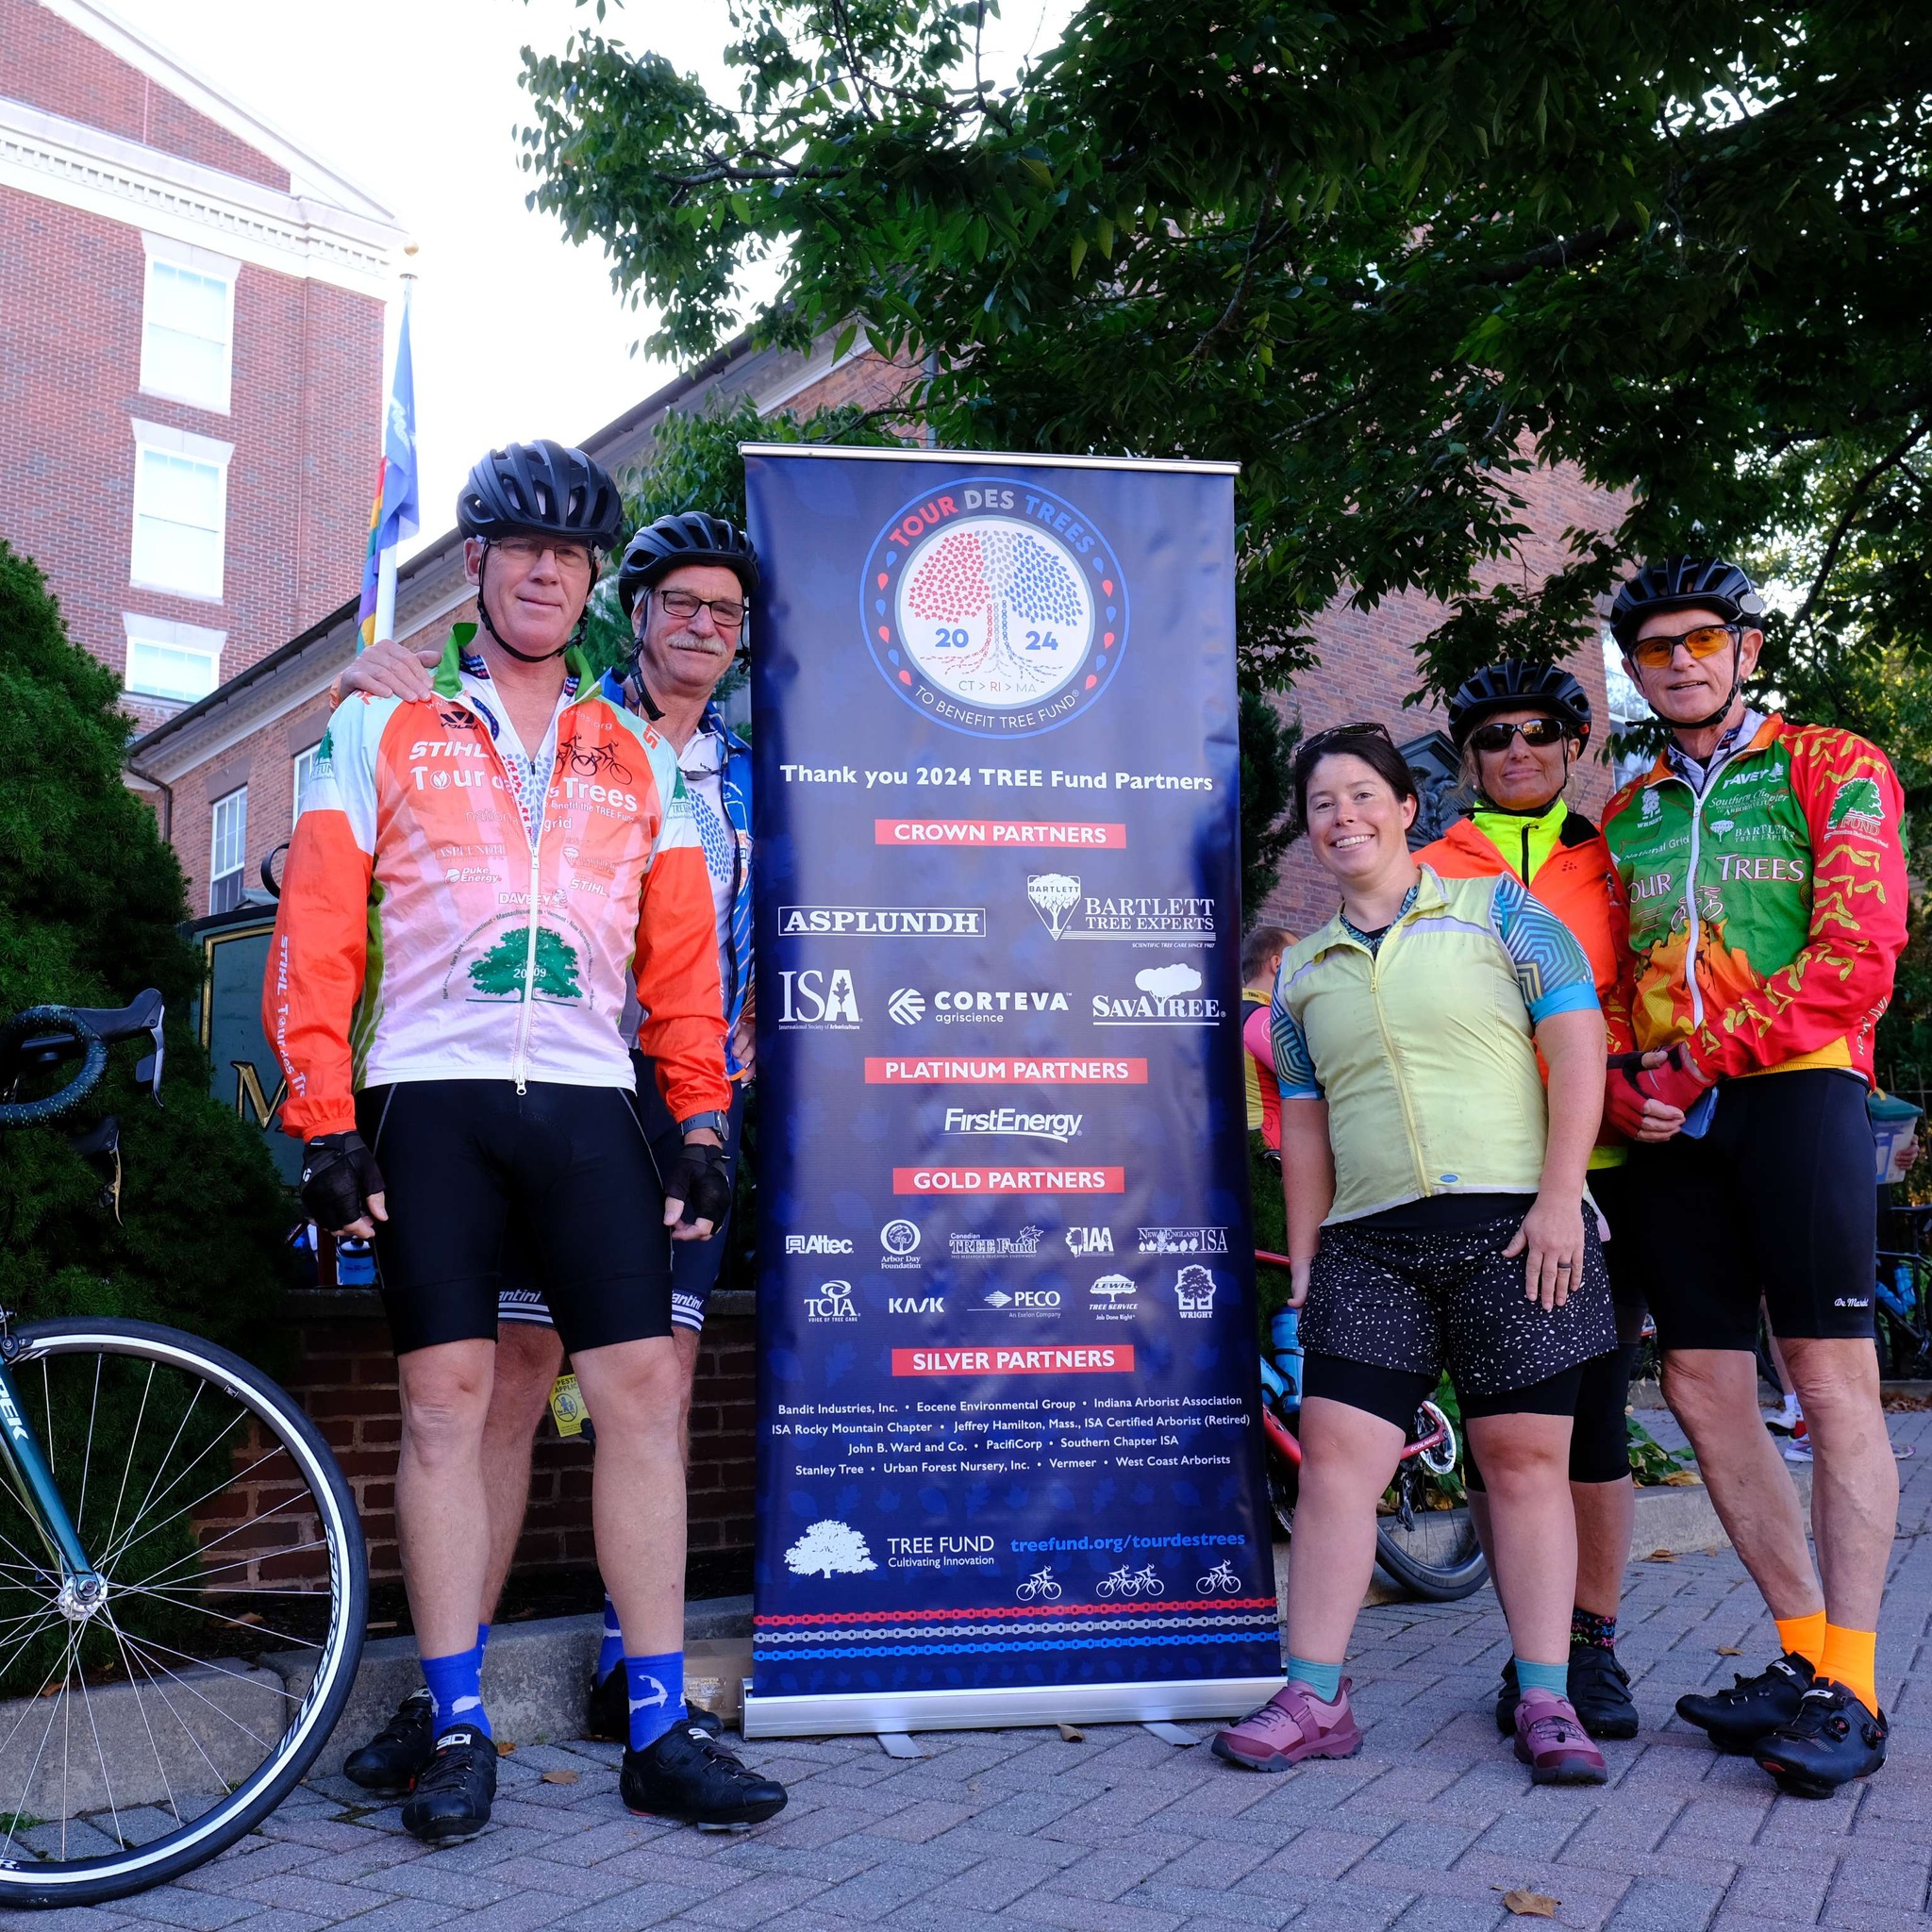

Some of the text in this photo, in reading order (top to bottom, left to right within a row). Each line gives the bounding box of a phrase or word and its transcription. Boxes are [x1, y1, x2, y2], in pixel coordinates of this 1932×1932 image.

[889, 489, 1095, 554] TOUR DES TREES
[935, 628, 1058, 651] 20 24
[958, 680, 1037, 693] CT RI MA
[915, 685, 934, 706] TO
[937, 700, 994, 728] BENEFIT
[1000, 710, 1036, 728] TREE
[409, 741, 490, 759] STIHL
[779, 764, 1214, 791] Thank you 2024 TREE Fund Partners
[409, 766, 485, 791] Tour
[563, 776, 638, 811] Trees
[1708, 793, 1752, 808] Southern
[596, 806, 614, 817] TREE
[543, 817, 573, 832] grid
[1637, 815, 1663, 829] WRIGHT
[1840, 818, 1880, 836] FUND
[894, 824, 1108, 844] CROWN PARTNERS
[1624, 835, 1690, 860] National Grid
[1715, 853, 1805, 883] TREES
[460, 874, 499, 884] Energy
[569, 879, 608, 896] STIHL
[1627, 873, 1672, 904] OUR
[1085, 897, 1215, 916] BARTLETT
[784, 910, 979, 933] ASPLUNDH
[1086, 917, 1215, 930] TREE EXPERTS
[276, 935, 289, 996] STIHL
[778, 969, 859, 1023] ISA
[936, 1013, 1004, 1024] agriscience
[886, 1061, 1129, 1079] PLATINUM PARTNERS
[944, 1108, 1082, 1136] FirstEnergy
[913, 1171, 1106, 1190] GOLD PARTNERS
[806, 1235, 853, 1254] Altec
[949, 1238, 1037, 1254] TREE Fund
[1200, 1229, 1228, 1251] ISA
[906, 1256, 921, 1264] Day
[498, 1289, 541, 1304] antini
[672, 1291, 705, 1310] antini
[889, 1297, 944, 1313] KASK
[1015, 1291, 1060, 1307] PECO
[804, 1296, 858, 1317] TCIA
[913, 1350, 1115, 1370] SILVER PARTNERS
[555, 1383, 577, 1393] APPLIC
[557, 1376, 576, 1386] PESTI
[0, 1377, 28, 1441] REK
[778, 1396, 1241, 1414] Bandit Industries, Inc. Eocene Environmental Group Indiana Arborist Association
[772, 1414, 1250, 1436] ISA Rocky Mountain Chapter Jeffrey Hamilton, Mass., ISA Certified Arborist (Retired)
[848, 1435, 1178, 1456] John B. Ward and Co. PacifiCorp Southern Chapter ISA
[795, 1455, 1231, 1476] Stanley Tree Urban Forest Nursery, Inc. Vermeer West Coast Arborists
[887, 1536, 994, 1555] TREE FUND
[1010, 1532, 1245, 1555] treefund.org/tourdestrees
[888, 1556, 994, 1569] Cultivating Innovation
